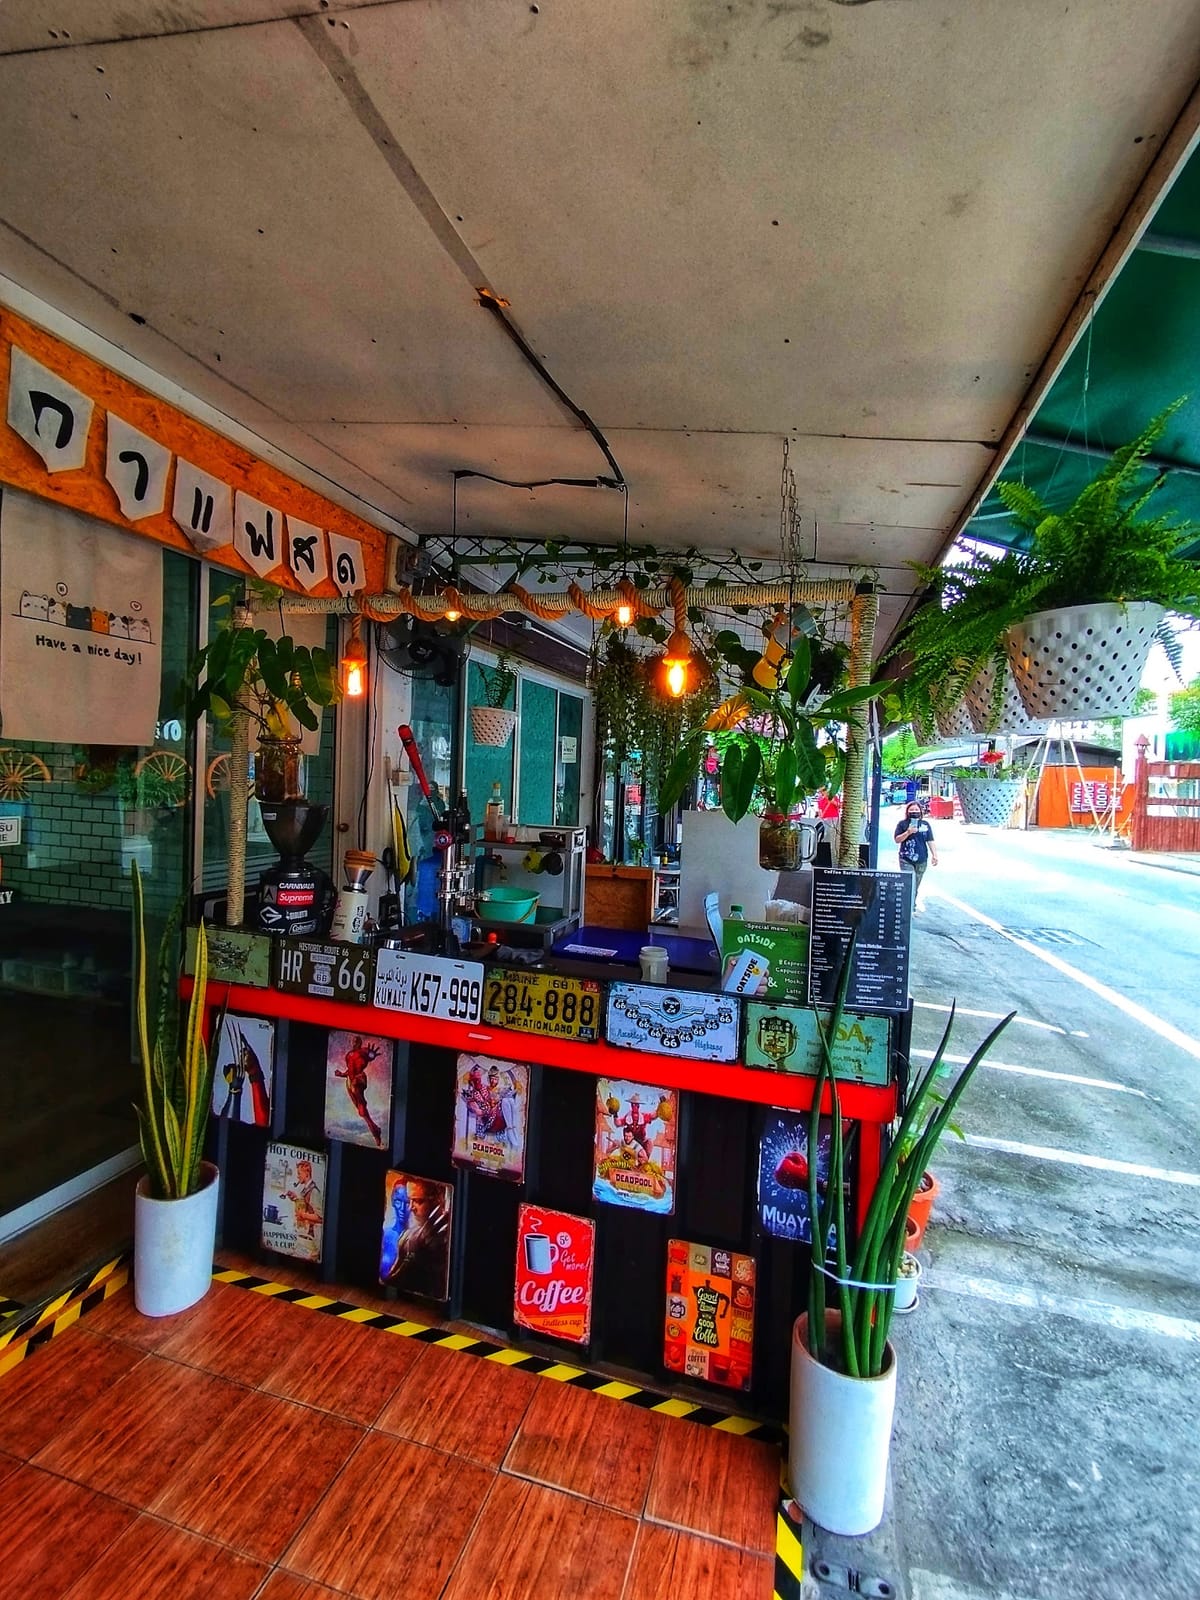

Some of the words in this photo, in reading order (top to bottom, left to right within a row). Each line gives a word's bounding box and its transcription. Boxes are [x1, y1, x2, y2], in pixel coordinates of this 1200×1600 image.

[36, 635, 67, 650] Have
[72, 643, 81, 653] a
[87, 644, 110, 657] nice
[114, 648, 142, 665] day!
[280, 893, 313, 903] Supreme
[737, 933, 776, 950] OATSIDE
[299, 942, 322, 953] HISTORIC
[324, 945, 340, 956] ROUTE
[342, 948, 349, 957] 66
[363, 950, 370, 959] 26
[281, 949, 303, 983] HR
[338, 958, 366, 992] 66
[737, 958, 758, 992] OATSIDE
[768, 976, 778, 988] &
[488, 981, 594, 1026] 284-888
[627, 1011, 638, 1019] 66
[720, 1015, 731, 1023] 66
[505, 1016, 573, 1035] VACATIONLAND
[638, 1020, 650, 1028] 66
[650, 1030, 661, 1038] 66
[693, 1028, 705, 1036] 66
[663, 1037, 677, 1048] 66
[269, 1143, 288, 1157] HOT
[290, 1147, 321, 1164] COFFEE
[472, 1142, 505, 1156] DEADPOOL
[615, 1173, 652, 1188] DEADPOOL
[762, 1204, 807, 1229] MUAY
[521, 1279, 585, 1312] Coffee
[698, 1288, 718, 1304] Good
[569, 1319, 582, 1328] cup
